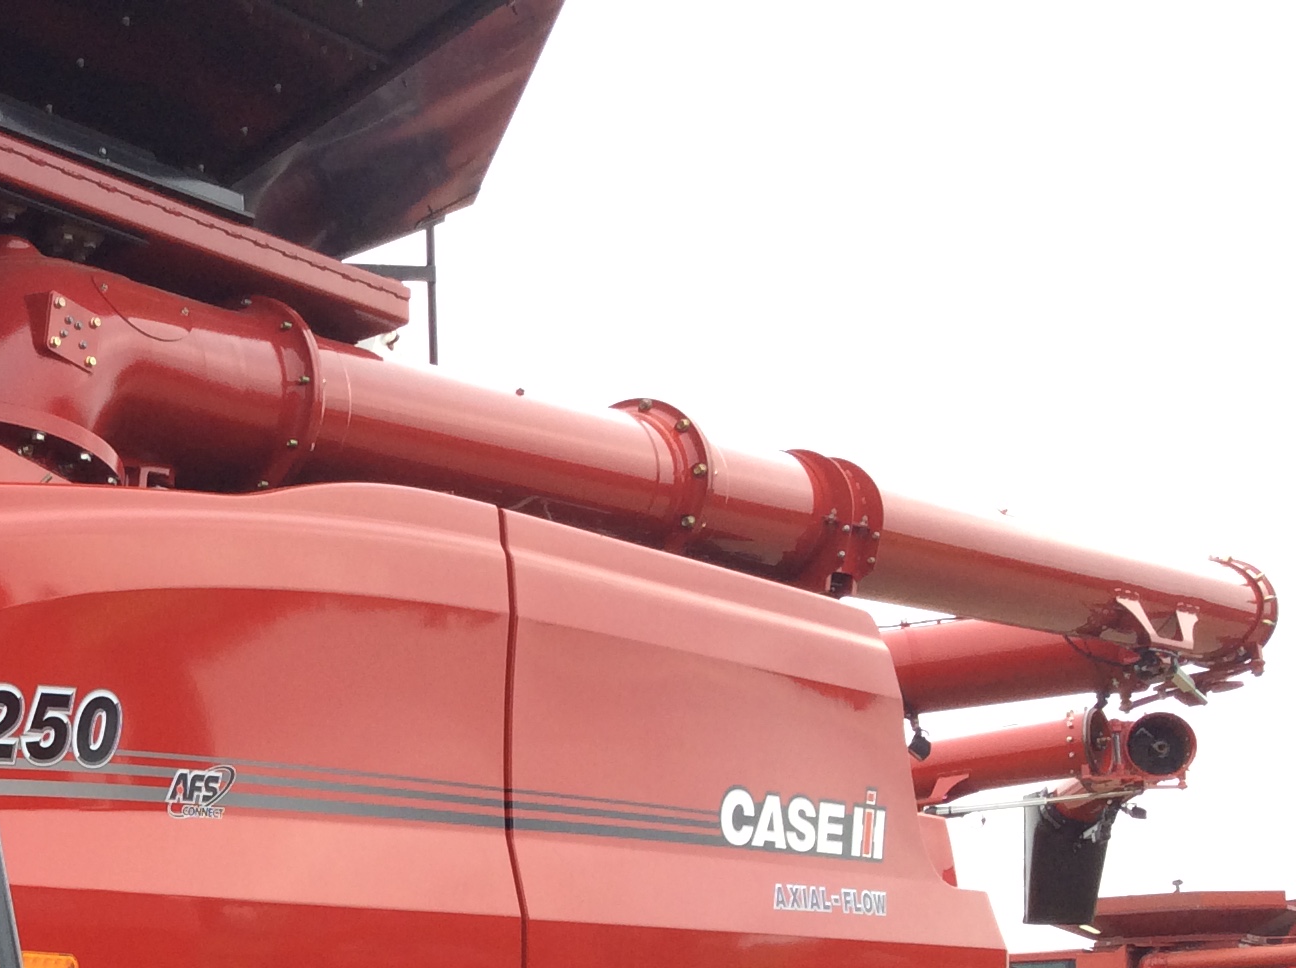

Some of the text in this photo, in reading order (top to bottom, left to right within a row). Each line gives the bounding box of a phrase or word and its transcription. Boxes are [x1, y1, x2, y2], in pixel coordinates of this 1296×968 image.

[165, 769, 222, 803] AFS
[182, 806, 224, 818] CONNECT
[720, 788, 846, 855] CASE
[773, 884, 887, 917] AXIAL-FLOW
